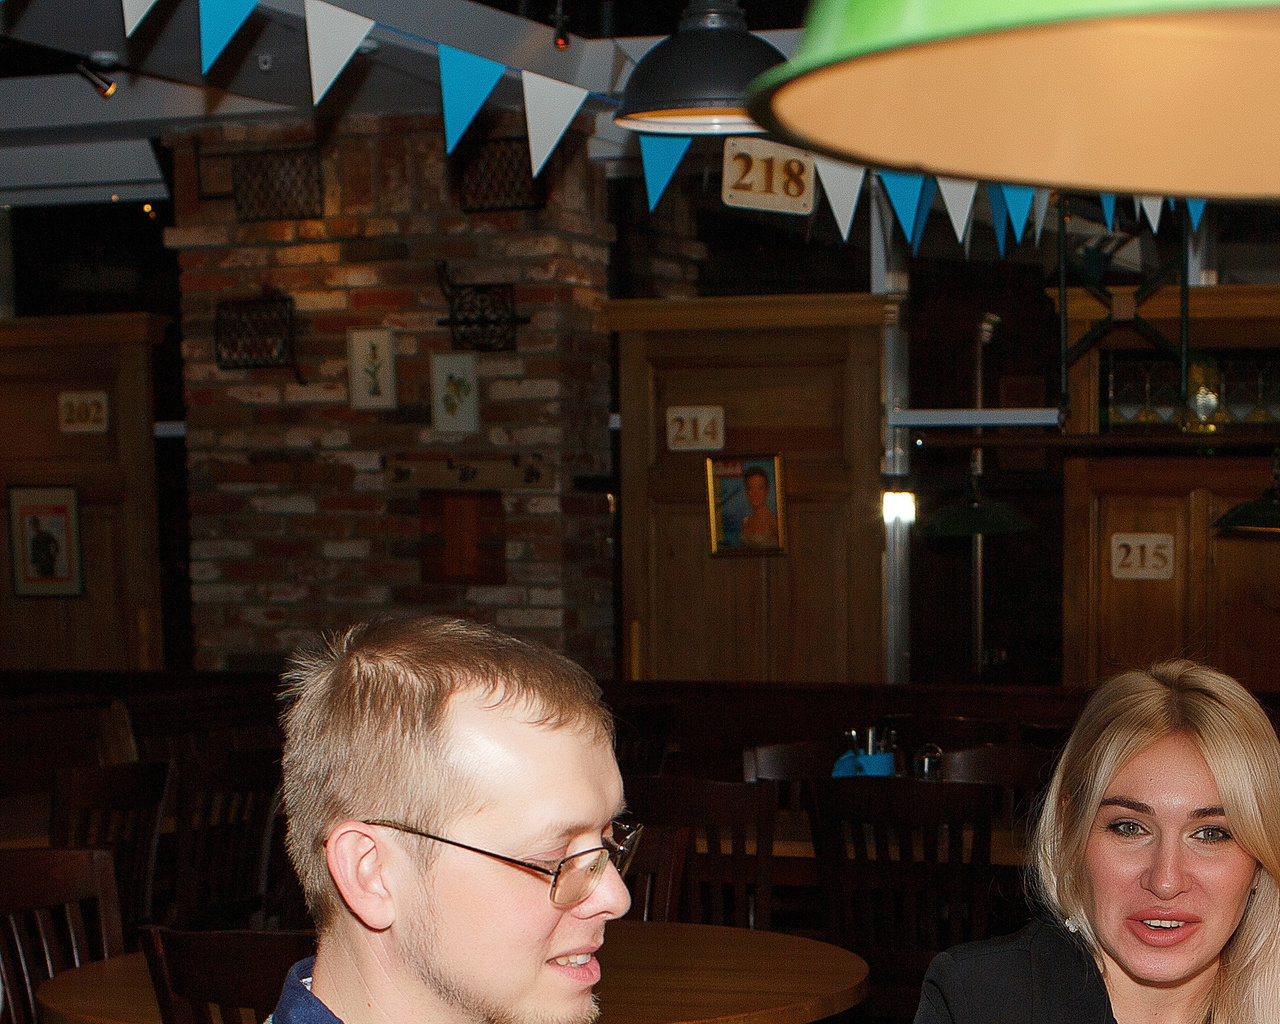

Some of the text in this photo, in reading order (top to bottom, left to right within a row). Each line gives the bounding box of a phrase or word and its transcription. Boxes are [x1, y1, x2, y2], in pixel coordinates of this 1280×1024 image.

[731, 152, 806, 198] 218
[672, 416, 718, 442] 214
[1118, 543, 1168, 570] 215
